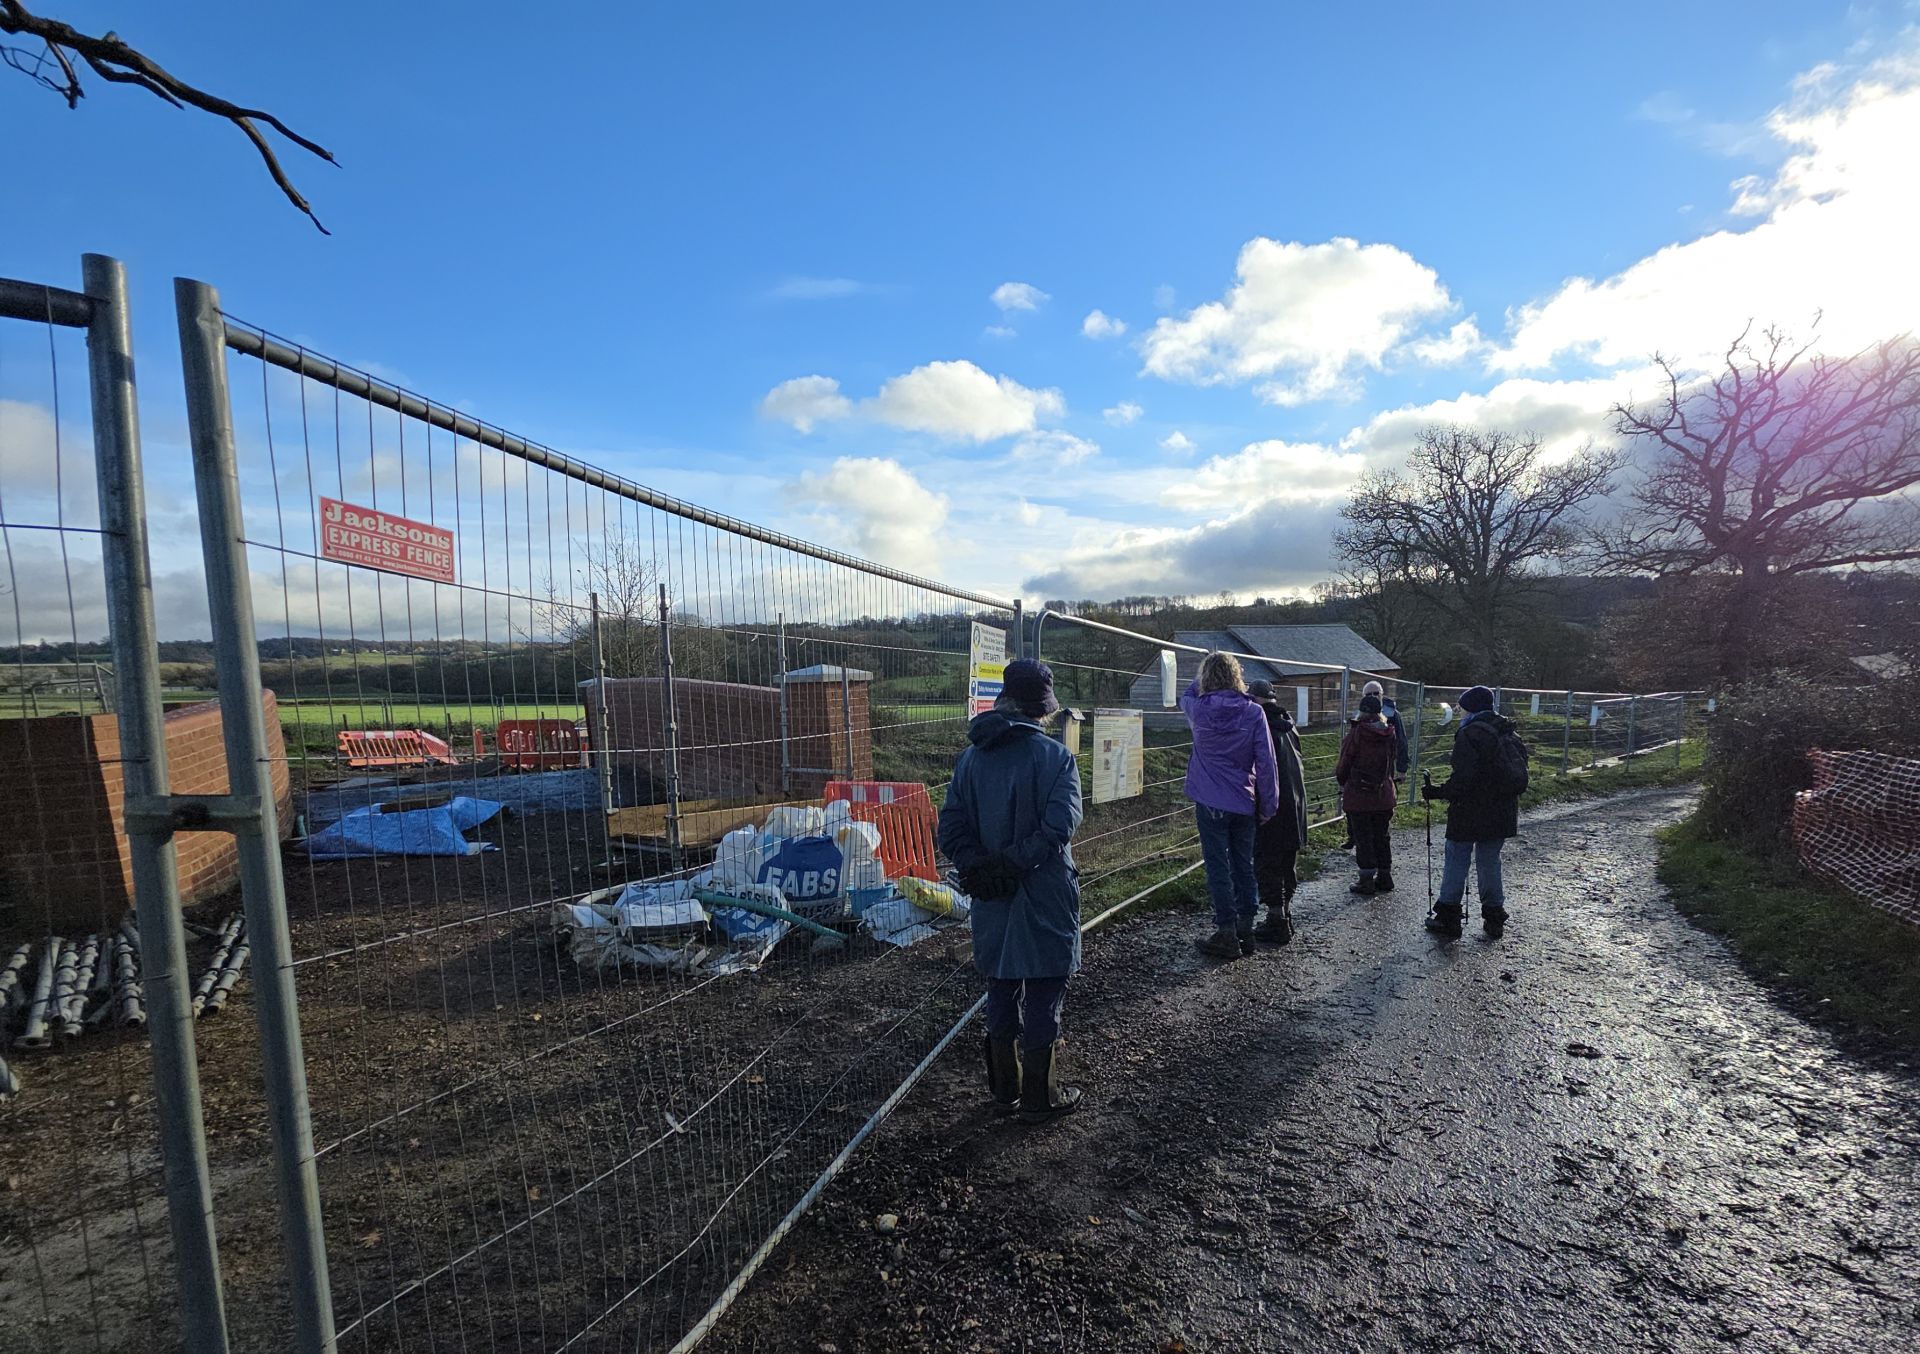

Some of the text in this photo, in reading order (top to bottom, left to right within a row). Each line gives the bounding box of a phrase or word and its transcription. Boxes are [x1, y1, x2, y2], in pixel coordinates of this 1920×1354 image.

[325, 503, 450, 549] Jacksons
[329, 527, 449, 569] EXPRESS FENCE
